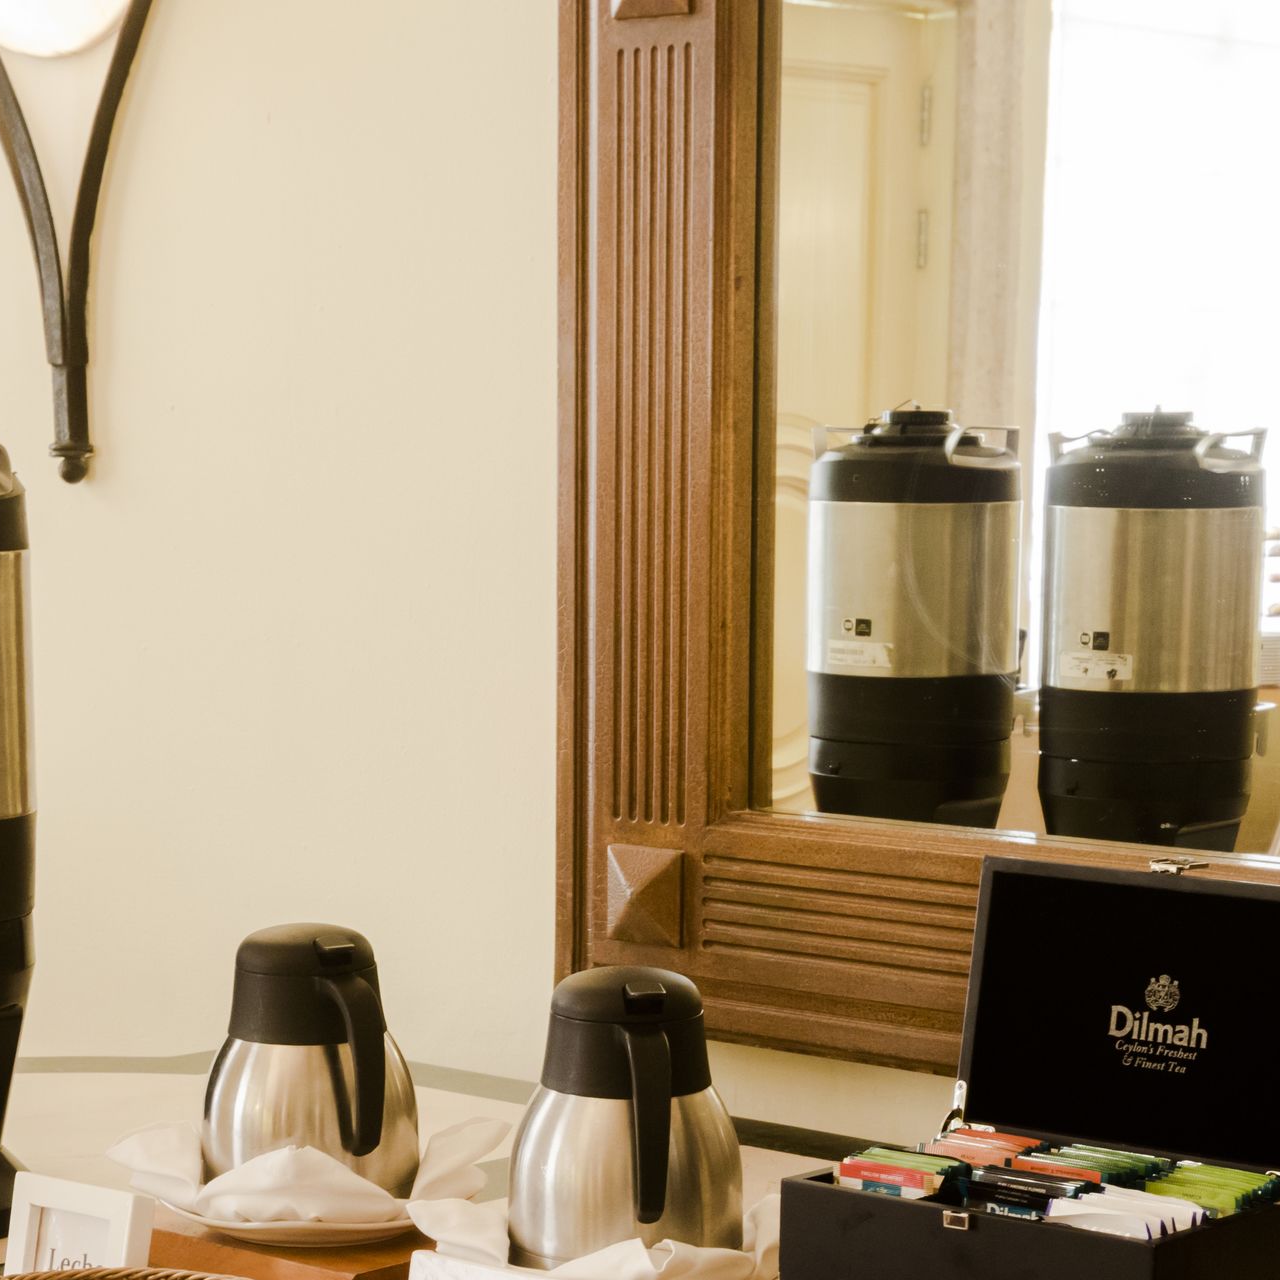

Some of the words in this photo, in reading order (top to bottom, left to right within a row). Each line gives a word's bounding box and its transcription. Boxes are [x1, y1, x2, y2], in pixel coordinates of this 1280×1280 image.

[1108, 1005, 1208, 1049] Dilmah
[1115, 1040, 1155, 1056] Ceylon's
[1156, 1045, 1197, 1061] Freshest
[1134, 1057, 1167, 1071] Finest
[1168, 1061, 1187, 1074] Tea
[48, 1248, 103, 1272] Lech
